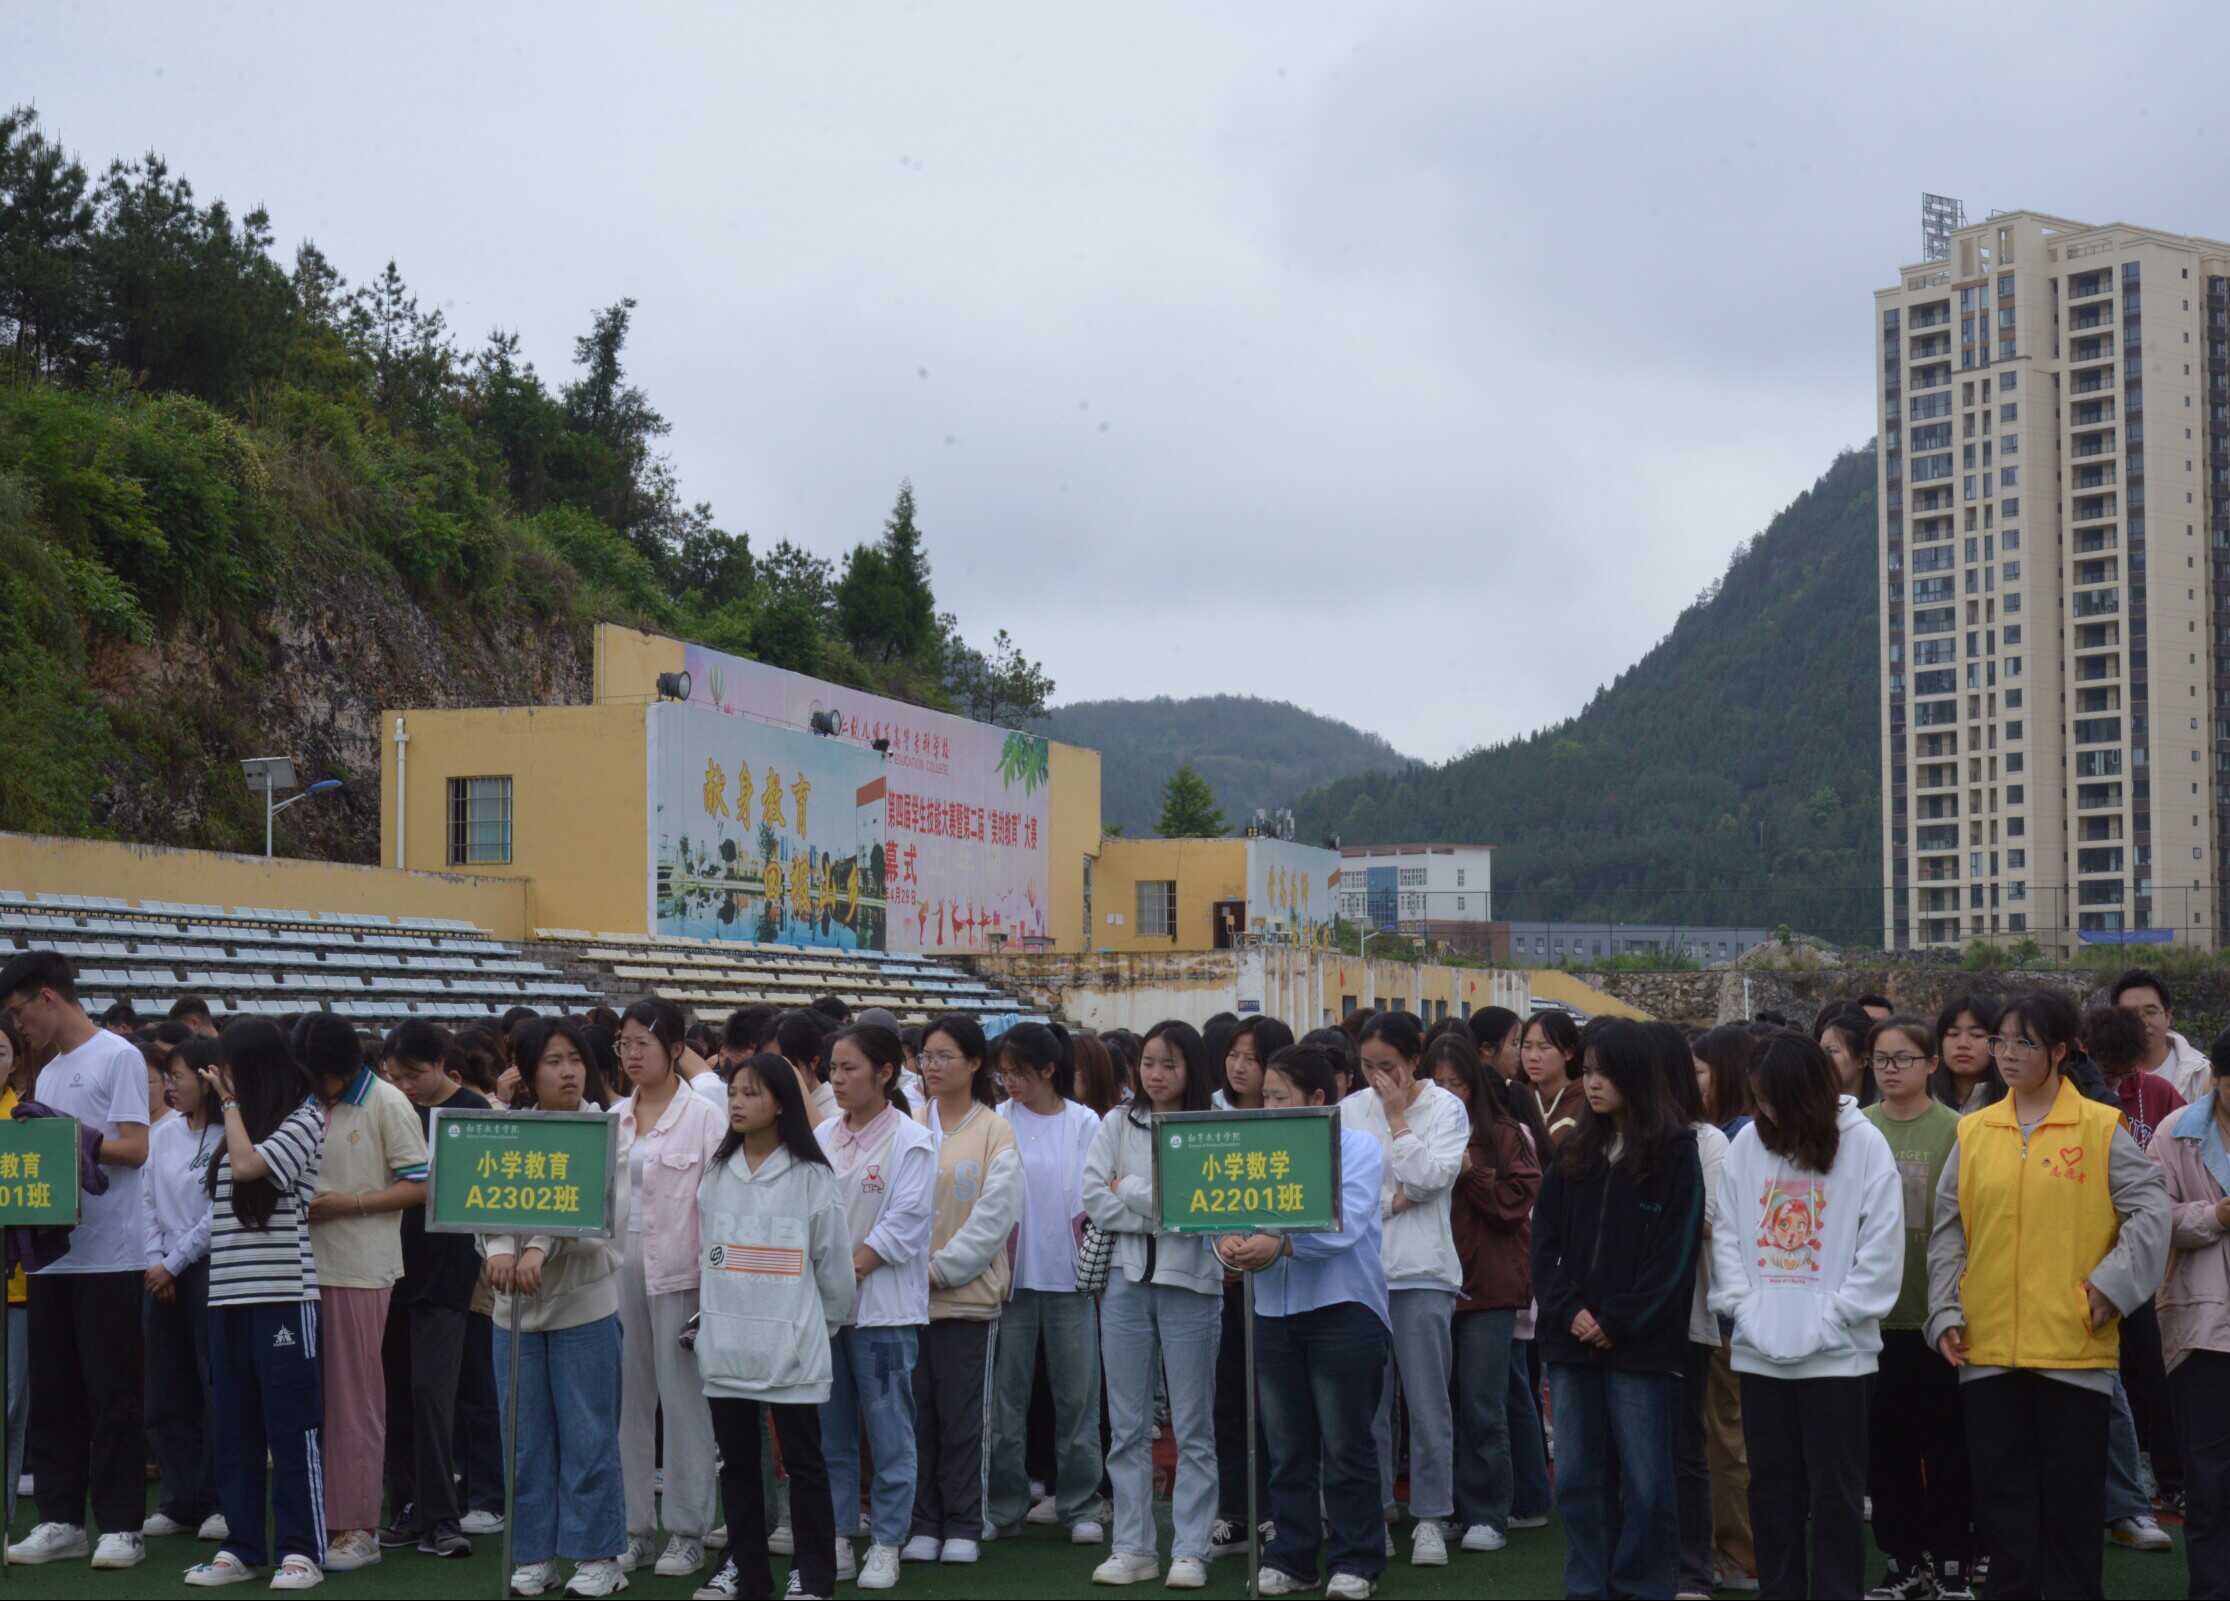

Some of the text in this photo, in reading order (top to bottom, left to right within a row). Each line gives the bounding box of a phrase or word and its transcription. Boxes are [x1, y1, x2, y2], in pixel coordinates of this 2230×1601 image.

[703, 756, 811, 839] 献身教育
[762, 850, 860, 924] 回报山乡
[0, 1152, 41, 1179] 教育
[477, 1151, 571, 1180] 小学教育
[953, 1159, 979, 1201] S
[1201, 1151, 1291, 1182] 小学数学
[0, 1182, 51, 1208] 01班
[464, 1184, 580, 1213] A2302班
[1189, 1183, 1304, 1214] A2201班
